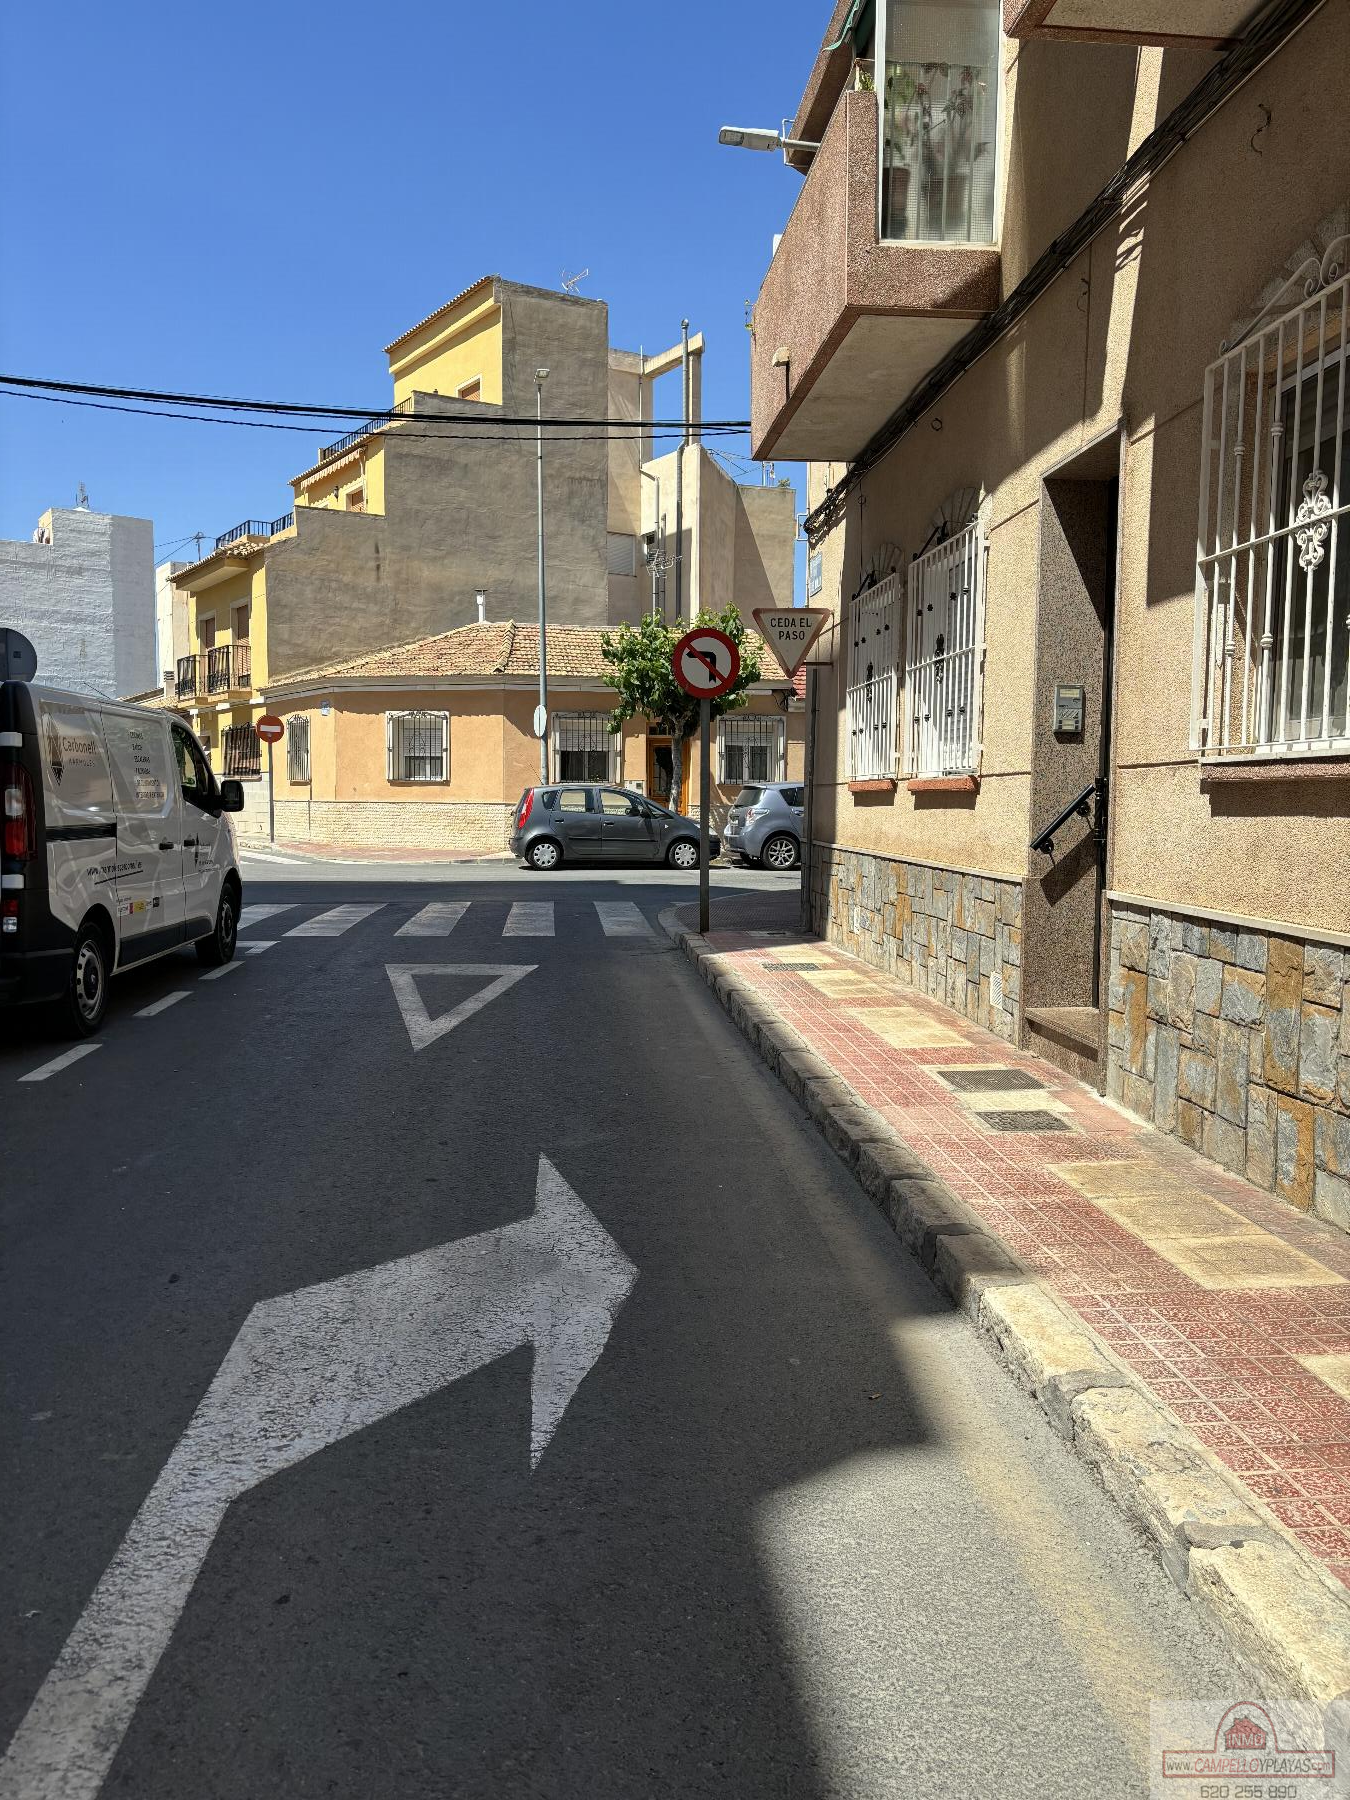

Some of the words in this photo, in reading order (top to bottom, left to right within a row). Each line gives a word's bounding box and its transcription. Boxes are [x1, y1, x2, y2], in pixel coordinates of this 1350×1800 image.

[770, 617, 796, 628] CEDA
[800, 617, 812, 628] EL
[779, 630, 805, 640] PASO
[62, 737, 97, 755] Carbonell
